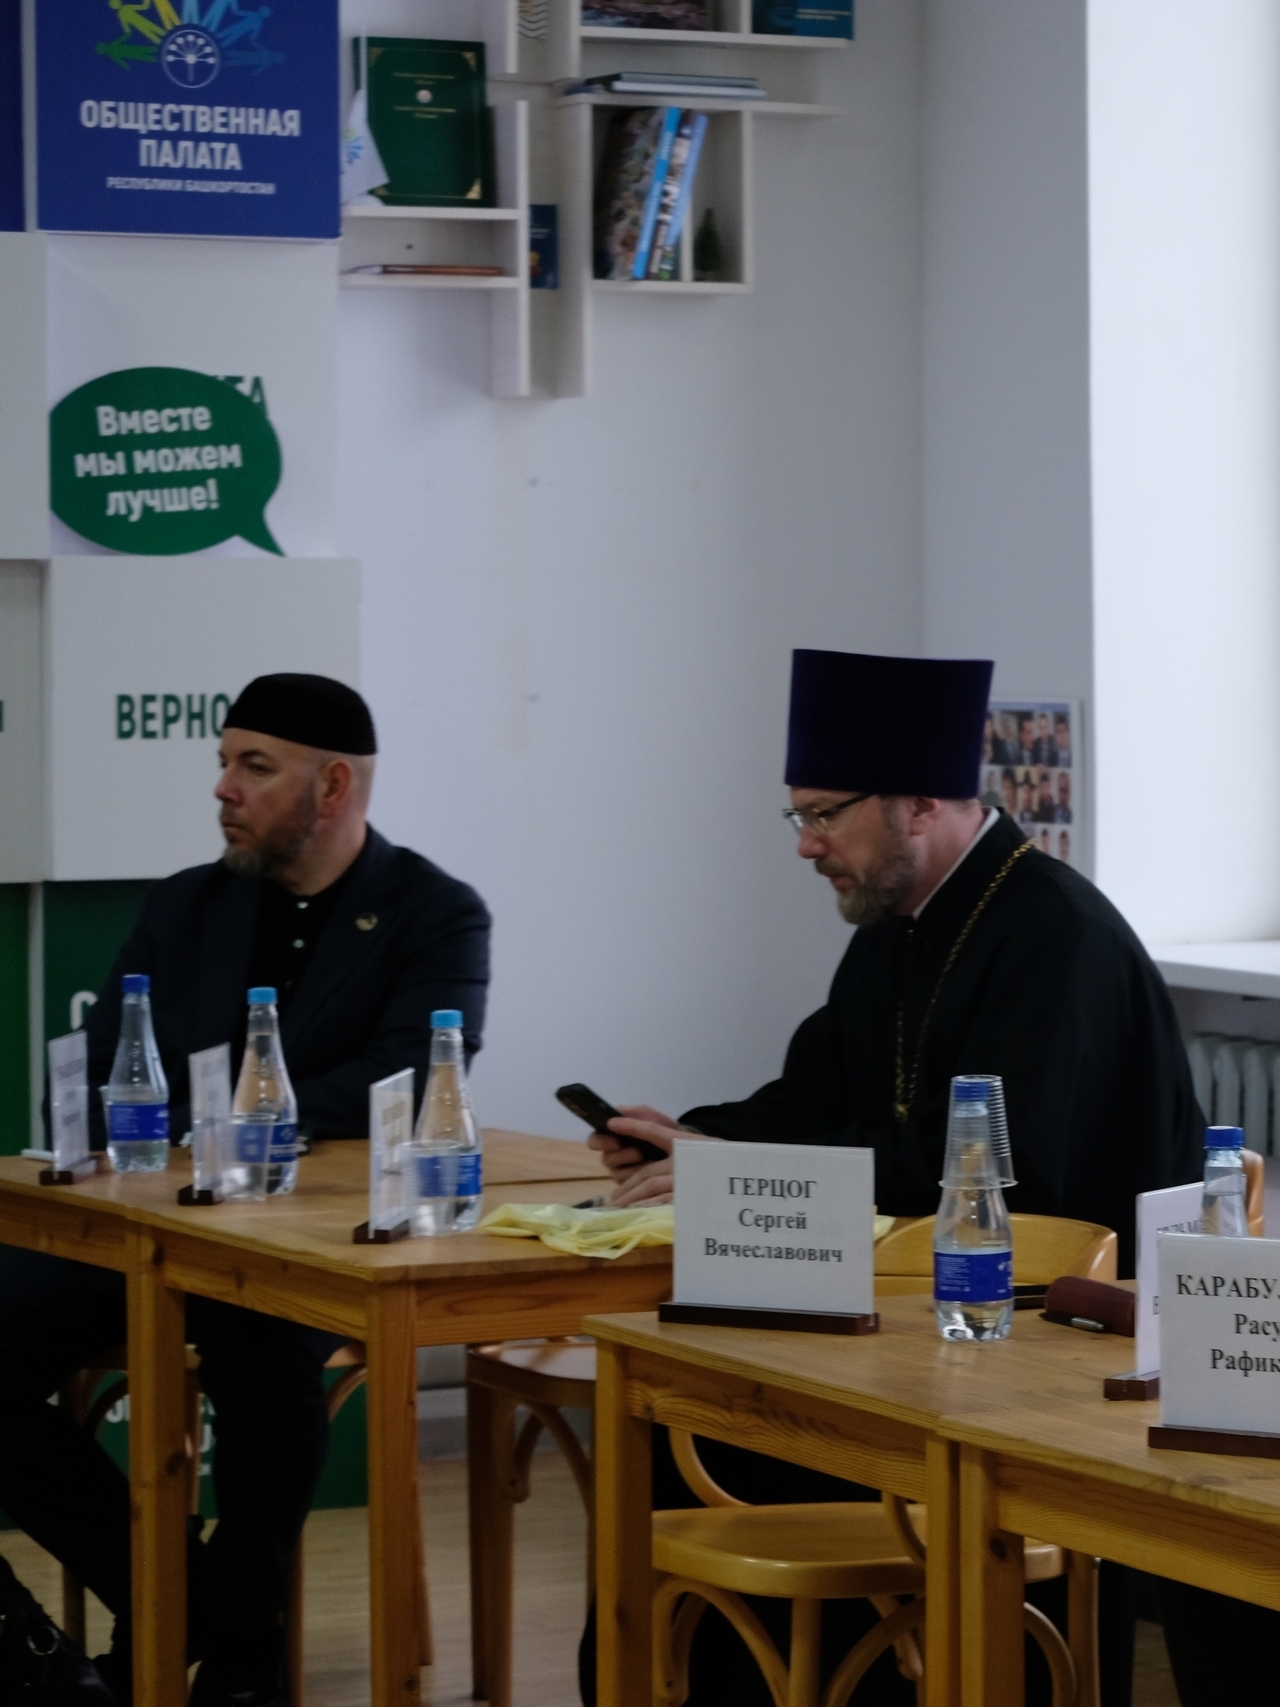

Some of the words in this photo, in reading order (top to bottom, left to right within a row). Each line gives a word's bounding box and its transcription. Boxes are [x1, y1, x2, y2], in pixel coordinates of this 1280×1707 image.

[80, 100, 300, 136] ОБЩЕСТВЕННАЯ
[139, 139, 242, 170] ПАЛАТА
[106, 176, 183, 191] РЕСПУБЛИКИ
[185, 179, 276, 195] БАШКОРТОСТАН
[96, 405, 212, 436] Вместе
[74, 451, 127, 478] мы
[133, 444, 243, 474] можем
[106, 478, 220, 522] лучше!
[728, 1176, 817, 1200] ГЕРЦОГ
[738, 1208, 808, 1233] Сергей
[704, 1237, 843, 1263] Вячеславович
